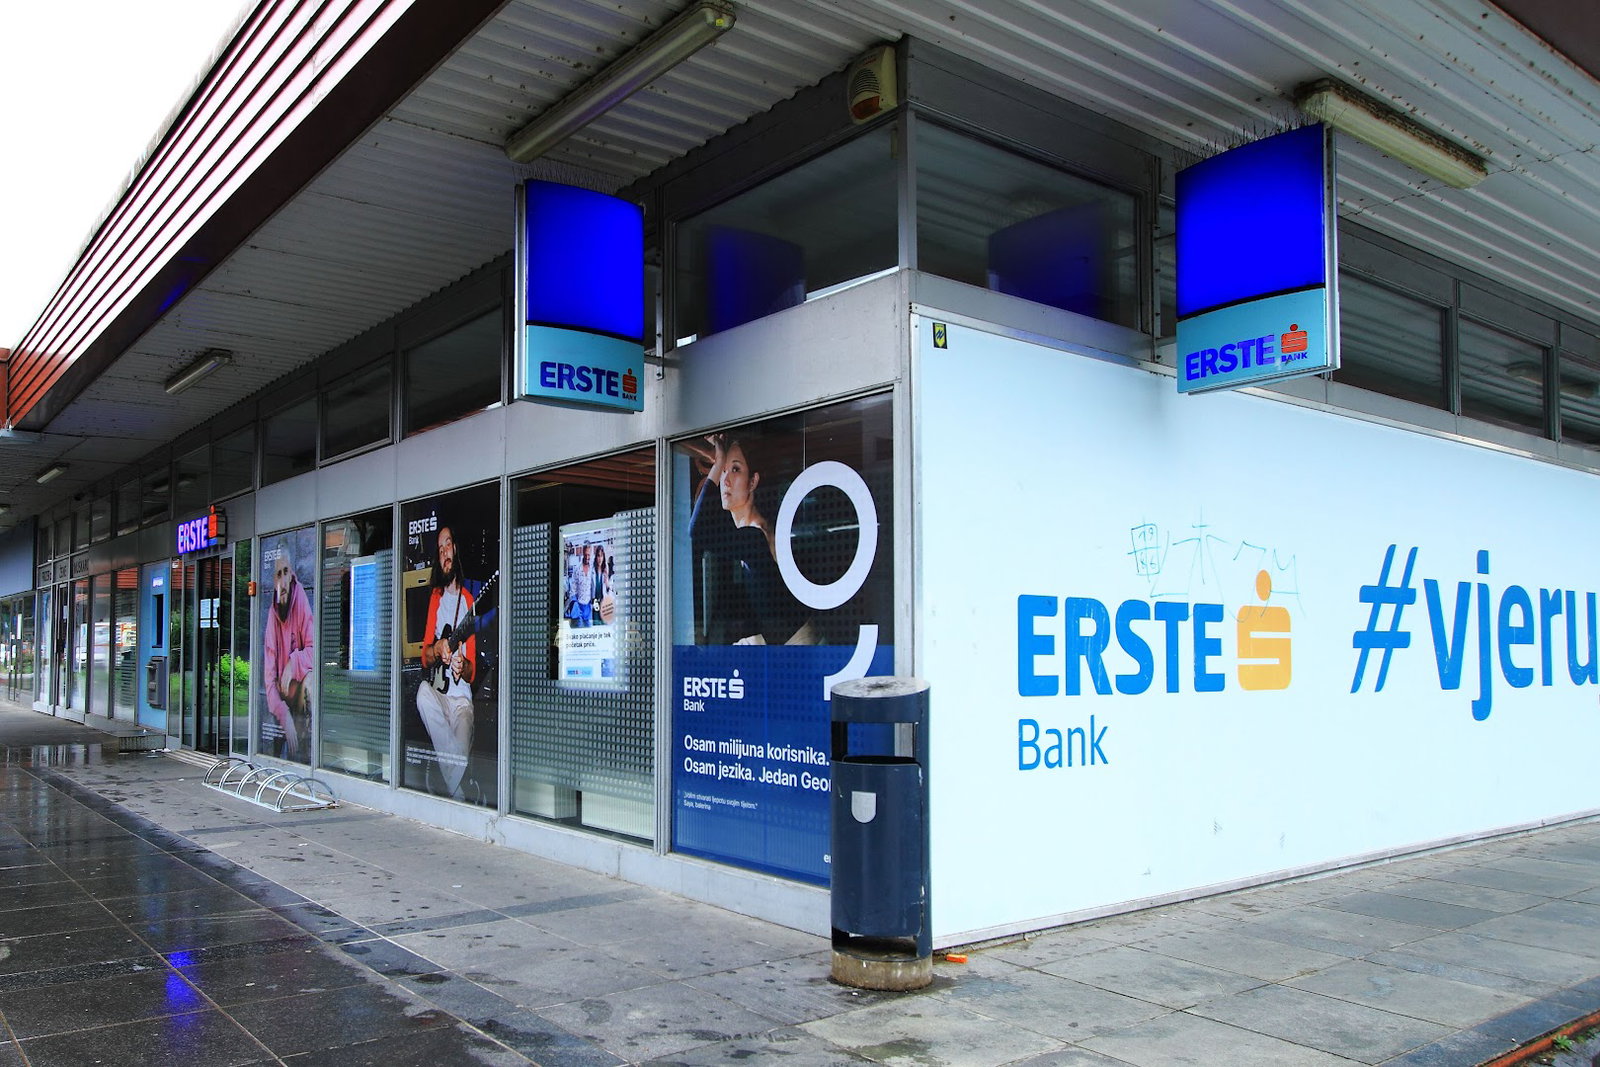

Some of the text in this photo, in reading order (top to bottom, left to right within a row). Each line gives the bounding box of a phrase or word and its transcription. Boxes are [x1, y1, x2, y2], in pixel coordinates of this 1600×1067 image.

[1185, 334, 1275, 381] ERSTE
[1281, 352, 1308, 363] BANK
[540, 361, 619, 397] ERSTE
[177, 516, 209, 555] ERSTE
[409, 518, 430, 535] ERSTE
[1017, 594, 1225, 697] ERSTE
[1350, 544, 1600, 722] #vjeru
[683, 677, 727, 698] ERSTE
[683, 699, 705, 712] Bank
[684, 734, 830, 766] Osam milijuna korisnika.
[1018, 714, 1109, 771] Bank
[684, 757, 716, 776] Osam
[718, 761, 756, 781] jezika.
[758, 766, 797, 787] Jedan
